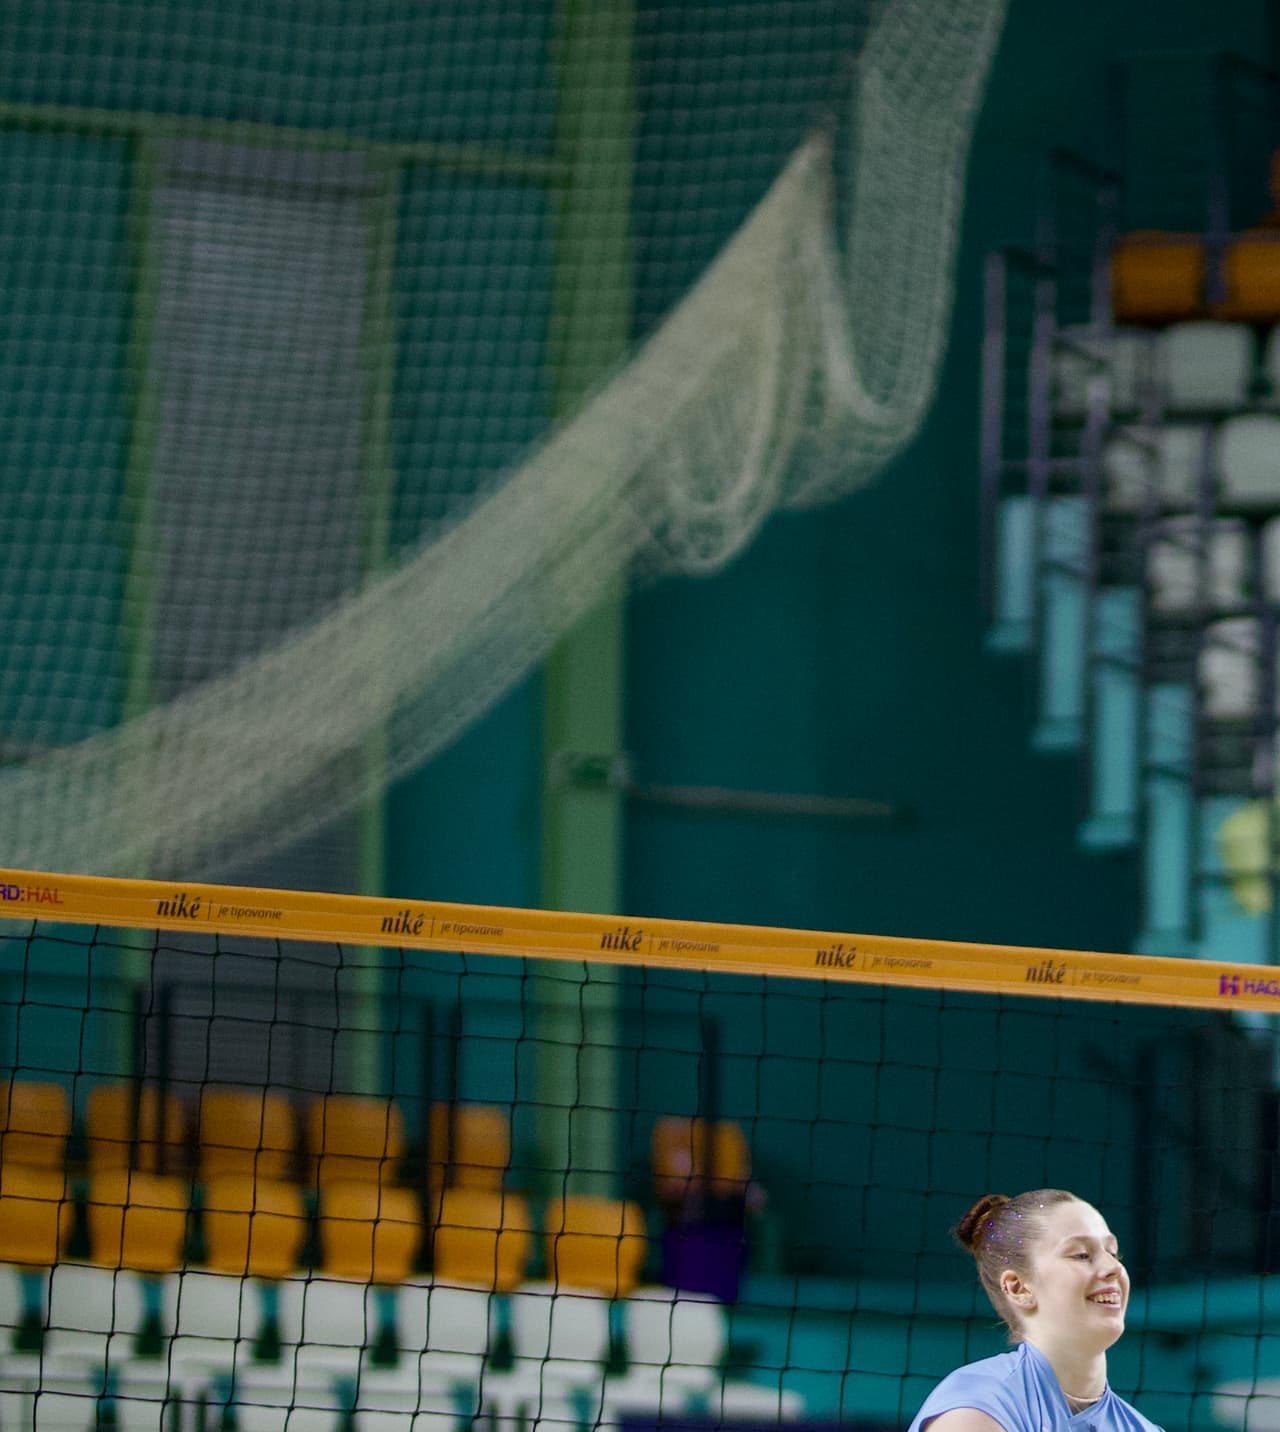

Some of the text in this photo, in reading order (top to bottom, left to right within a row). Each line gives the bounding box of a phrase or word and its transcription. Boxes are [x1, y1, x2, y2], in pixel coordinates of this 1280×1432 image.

[156, 893, 201, 918] niké
[380, 910, 424, 936] niké
[600, 928, 643, 953] niké
[815, 944, 857, 968] niké
[1025, 960, 1067, 984] niké
